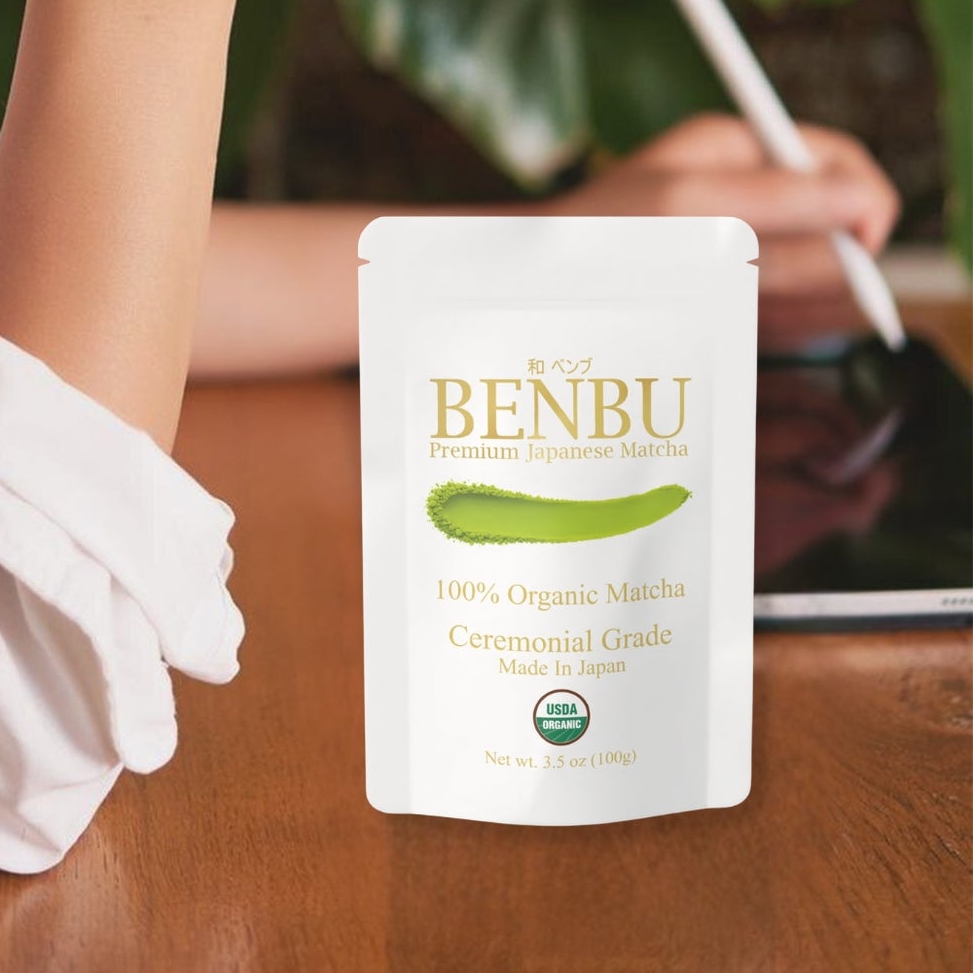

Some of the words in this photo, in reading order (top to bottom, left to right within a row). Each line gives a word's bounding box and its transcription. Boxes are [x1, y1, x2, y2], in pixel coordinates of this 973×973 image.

[430, 377, 692, 440] BENBU
[429, 442, 520, 460] Premium
[525, 443, 614, 464] Japanese
[620, 439, 689, 459] Matcha
[437, 579, 500, 604] 100%
[507, 583, 598, 611] Organic
[605, 578, 686, 604] Matcha
[448, 624, 593, 653] Ceremonial
[601, 624, 673, 651] Grade
[499, 657, 548, 676] Made
[555, 659, 572, 676] In
[578, 659, 627, 679] Japan
[546, 702, 578, 716] USDA
[542, 719, 582, 730] ORGANIC
[484, 750, 511, 767] Net
[515, 755, 538, 769] wt.
[542, 755, 565, 770] 3.5
[569, 758, 587, 768] oz
[590, 749, 637, 769] (100g)
